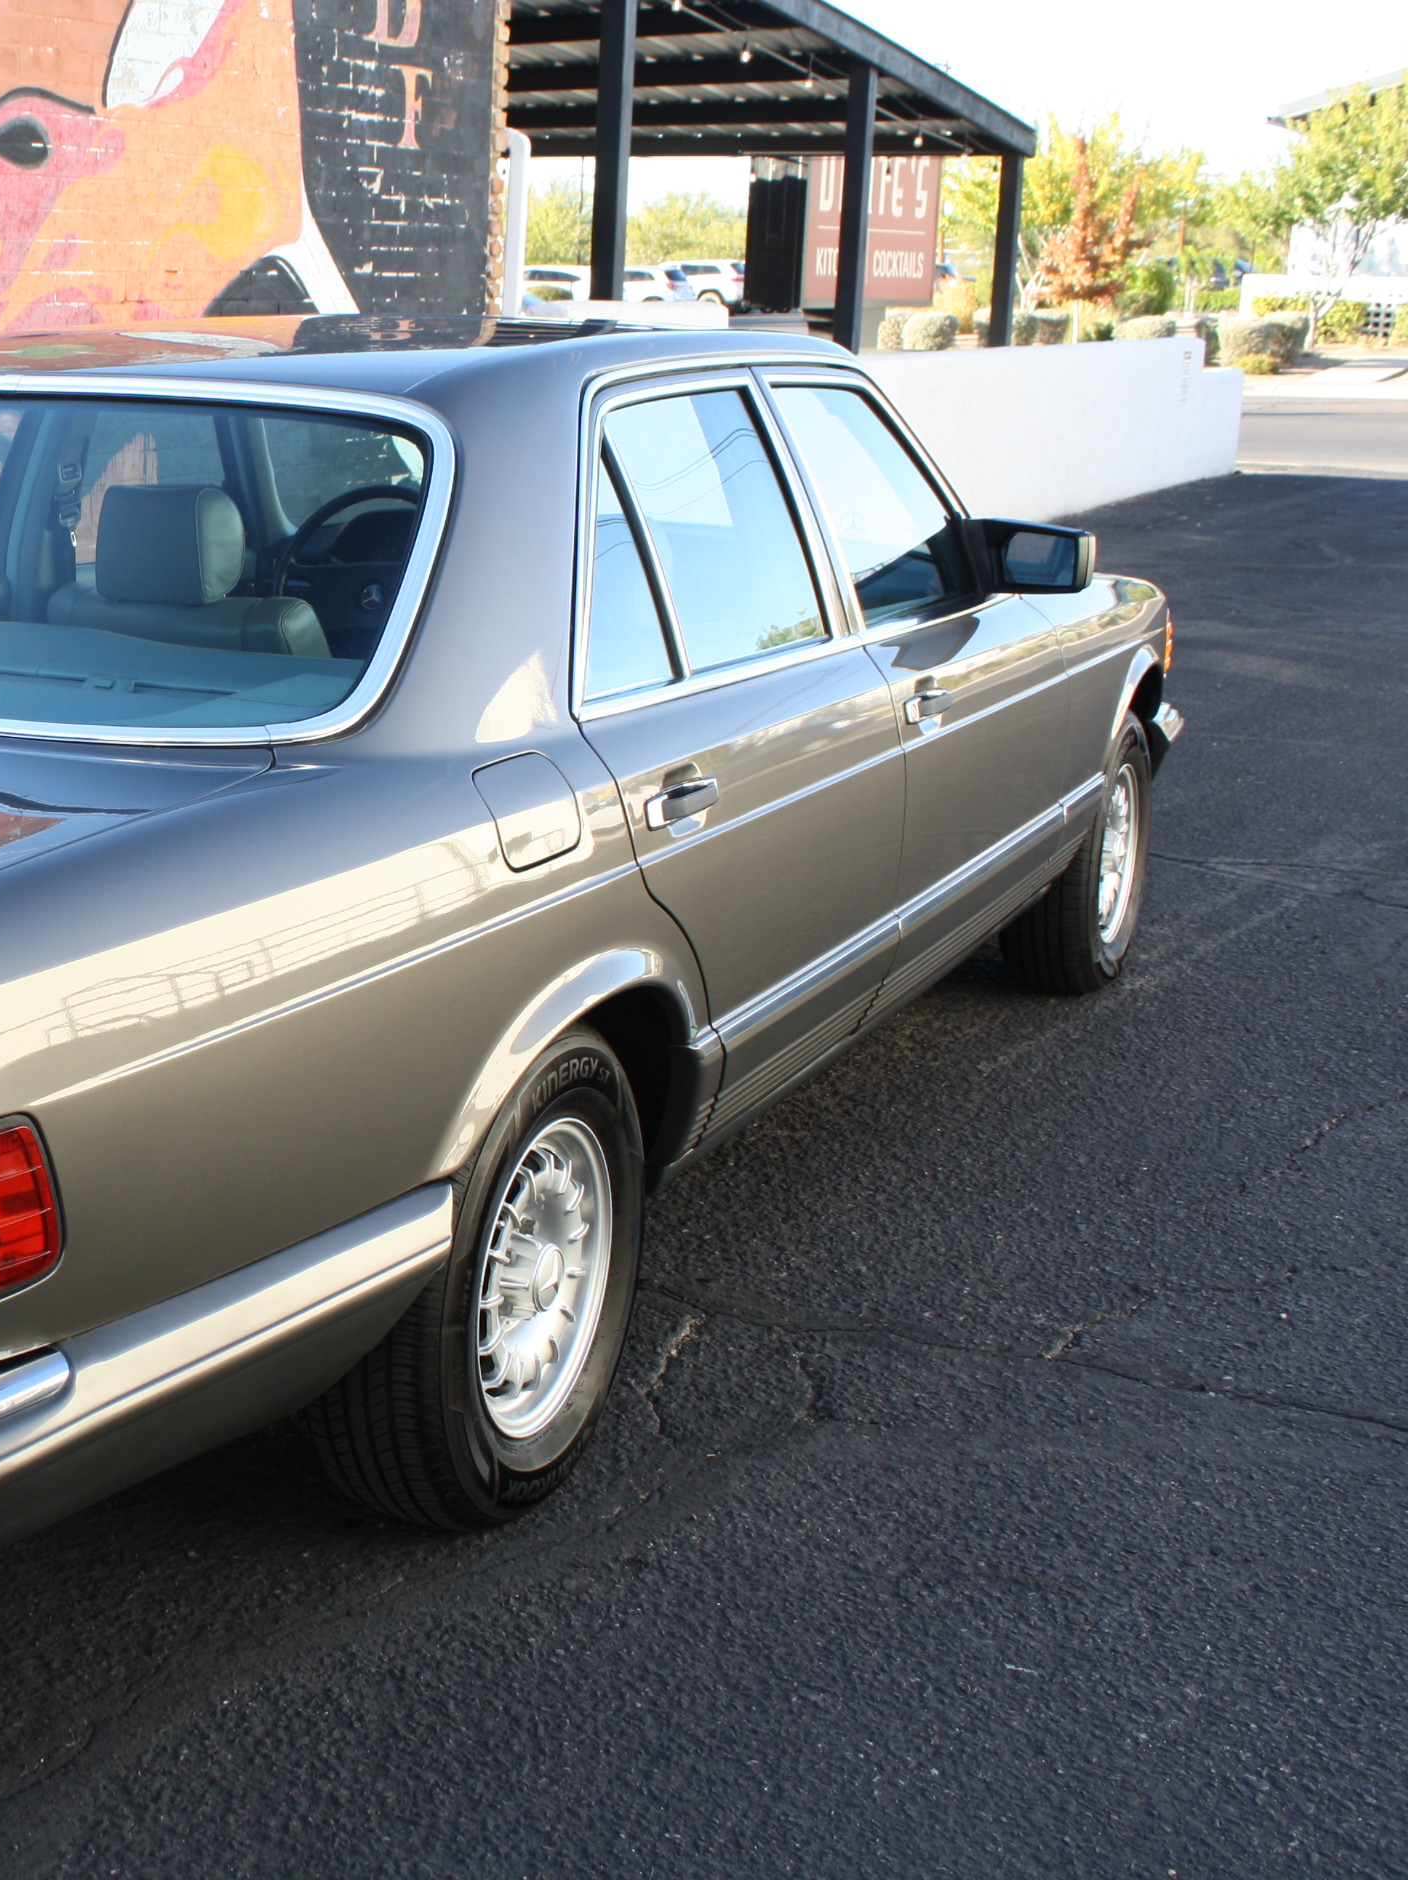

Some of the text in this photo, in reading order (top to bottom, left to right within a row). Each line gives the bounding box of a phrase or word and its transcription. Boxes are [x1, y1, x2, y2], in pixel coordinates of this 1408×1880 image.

[395, 64, 433, 149] F
[872, 248, 925, 279] COCKTAILS
[531, 1056, 612, 1115] KINERGY ST
